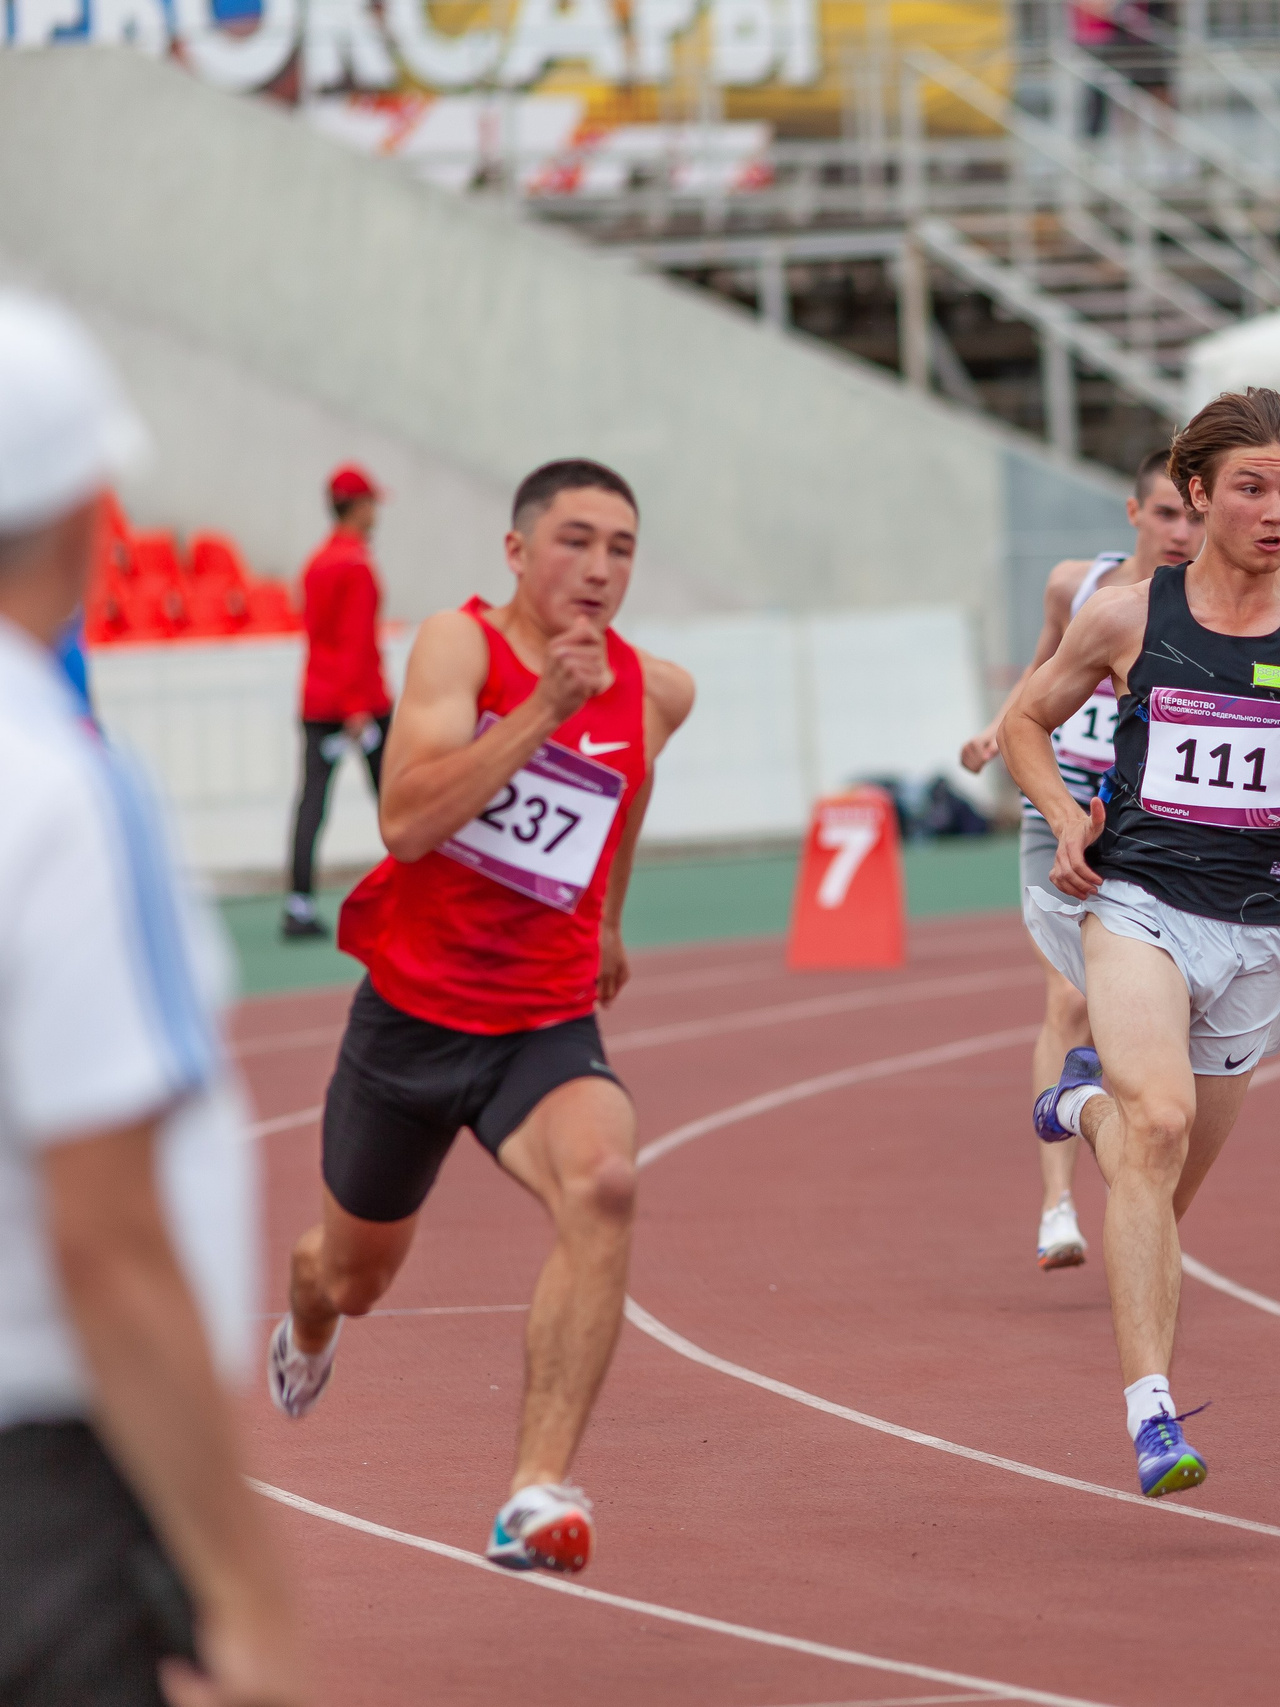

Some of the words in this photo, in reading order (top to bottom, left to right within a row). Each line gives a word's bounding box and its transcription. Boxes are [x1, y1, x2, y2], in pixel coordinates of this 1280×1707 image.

[1160, 704, 1211, 717] ПРИВОЛЖСКОГО
[1211, 711, 1262, 724] ФЕДЕРАЛЬНОГО
[1161, 696, 1216, 710] ПЕРВЕНСТВО
[1175, 738, 1267, 793] 111
[477, 782, 582, 855] 237
[1150, 803, 1190, 817] ЧЕБОКСАРЫ
[818, 826, 877, 909] 7
